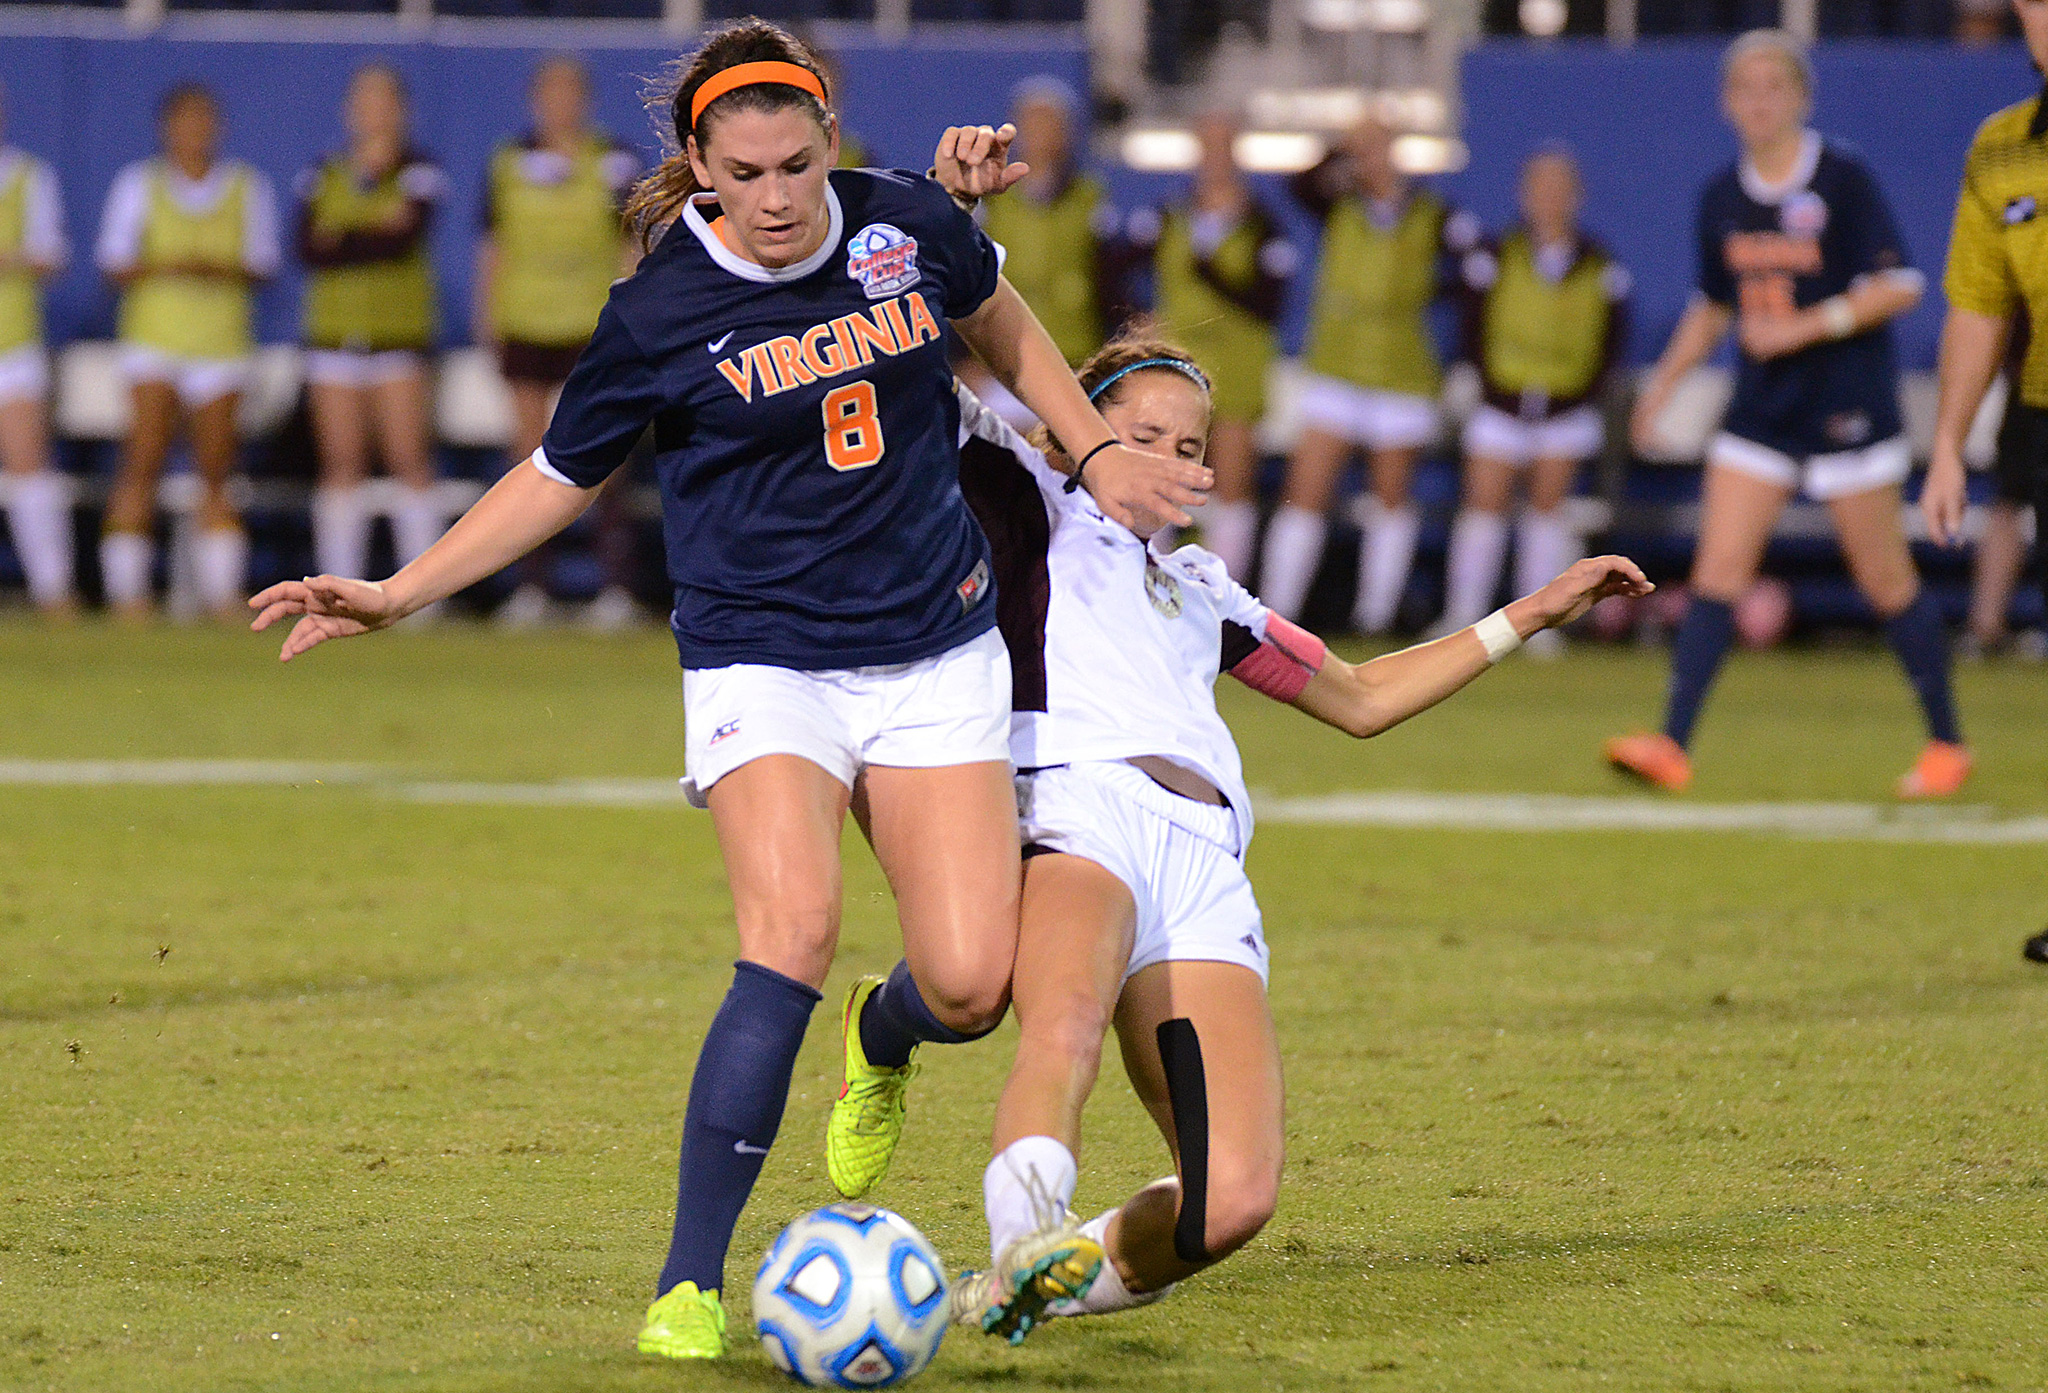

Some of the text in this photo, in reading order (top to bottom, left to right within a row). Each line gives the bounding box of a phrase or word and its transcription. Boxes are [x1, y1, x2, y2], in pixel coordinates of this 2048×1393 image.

[850, 242, 916, 274] College
[872, 261, 905, 283] Cup
[716, 292, 940, 403] VIRGINIA
[822, 380, 885, 472] 8
[711, 718, 740, 742] ACC
